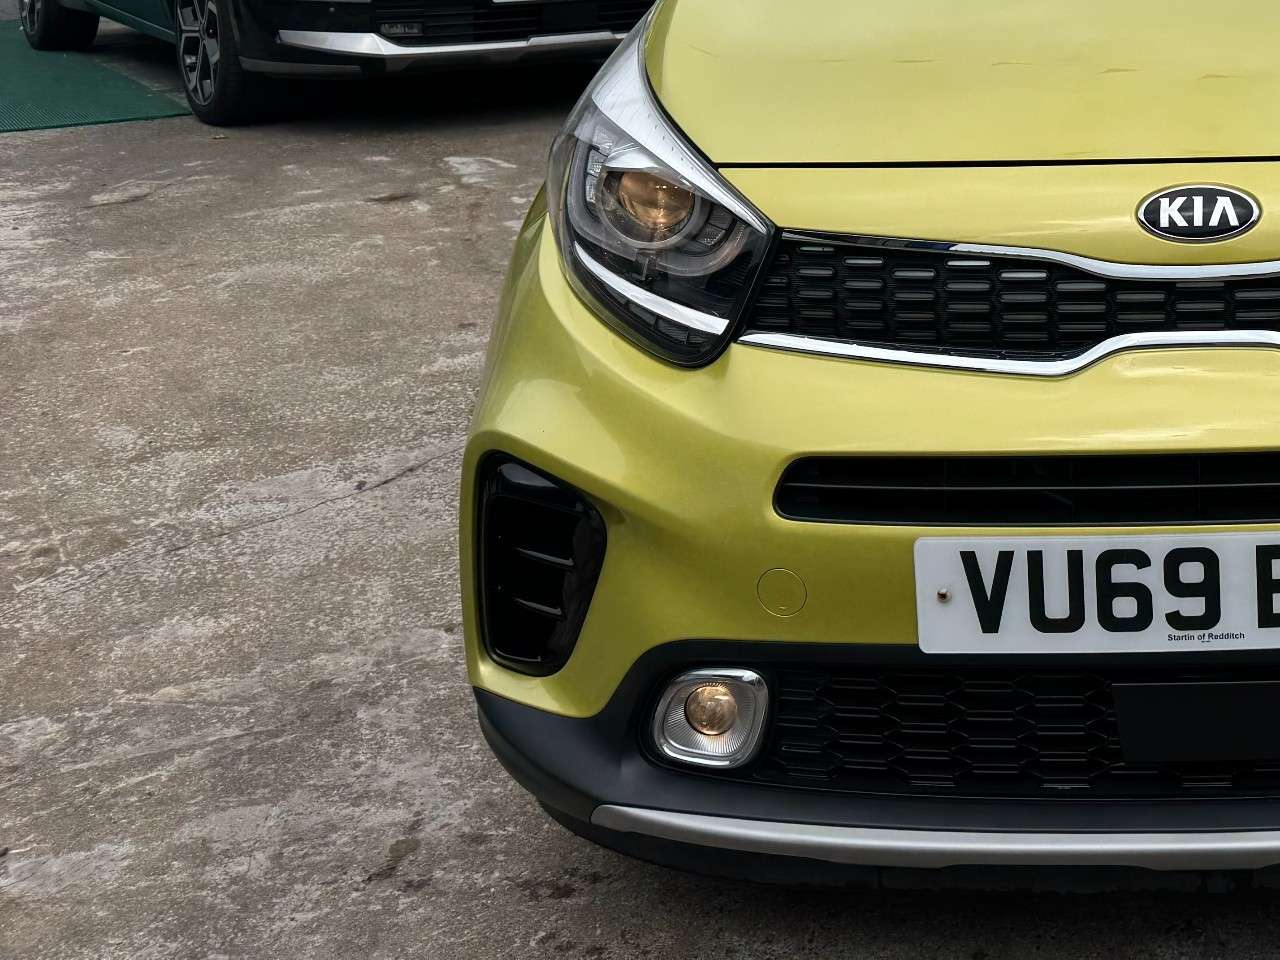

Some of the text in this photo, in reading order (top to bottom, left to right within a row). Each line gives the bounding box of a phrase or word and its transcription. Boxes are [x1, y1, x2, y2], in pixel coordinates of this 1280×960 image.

[1159, 196, 1239, 228] KIA
[959, 546, 1222, 634] VU69
[1167, 633, 1195, 641] Startin
[1198, 633, 1206, 641] of
[1208, 632, 1245, 641] Redditch
